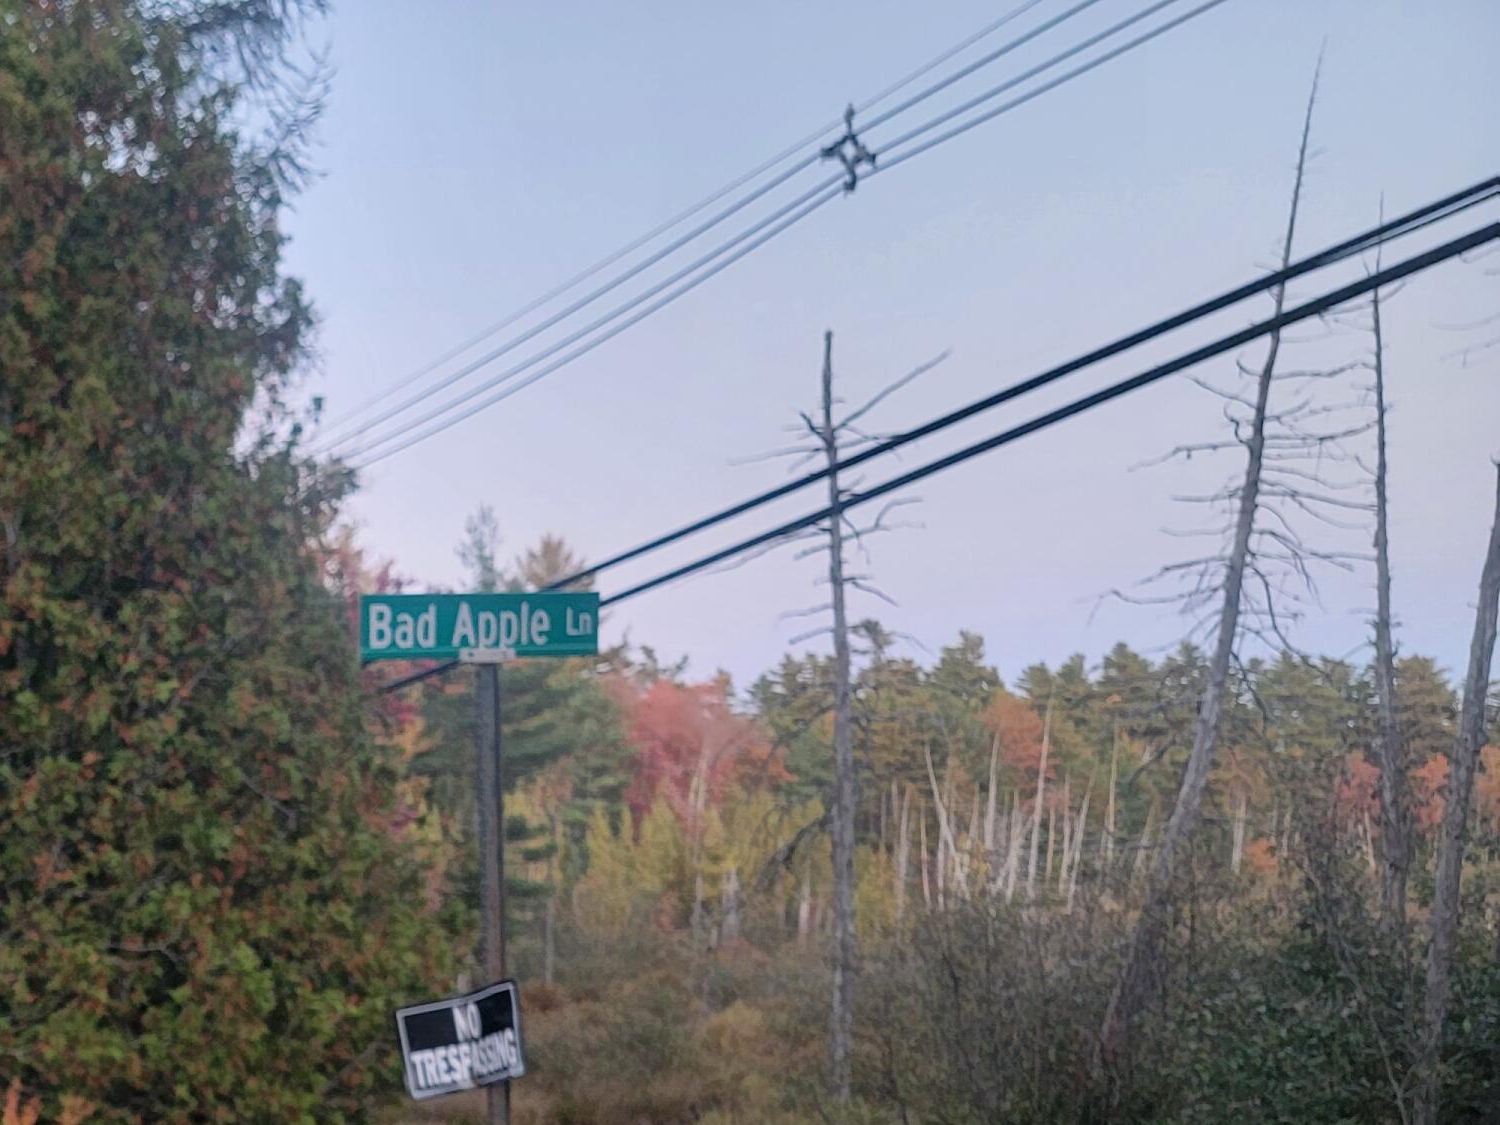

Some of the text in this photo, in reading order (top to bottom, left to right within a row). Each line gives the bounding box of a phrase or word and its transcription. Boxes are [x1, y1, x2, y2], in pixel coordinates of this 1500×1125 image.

[368, 600, 593, 650] Bad Apple Ln
[452, 1002, 482, 1042] NO
